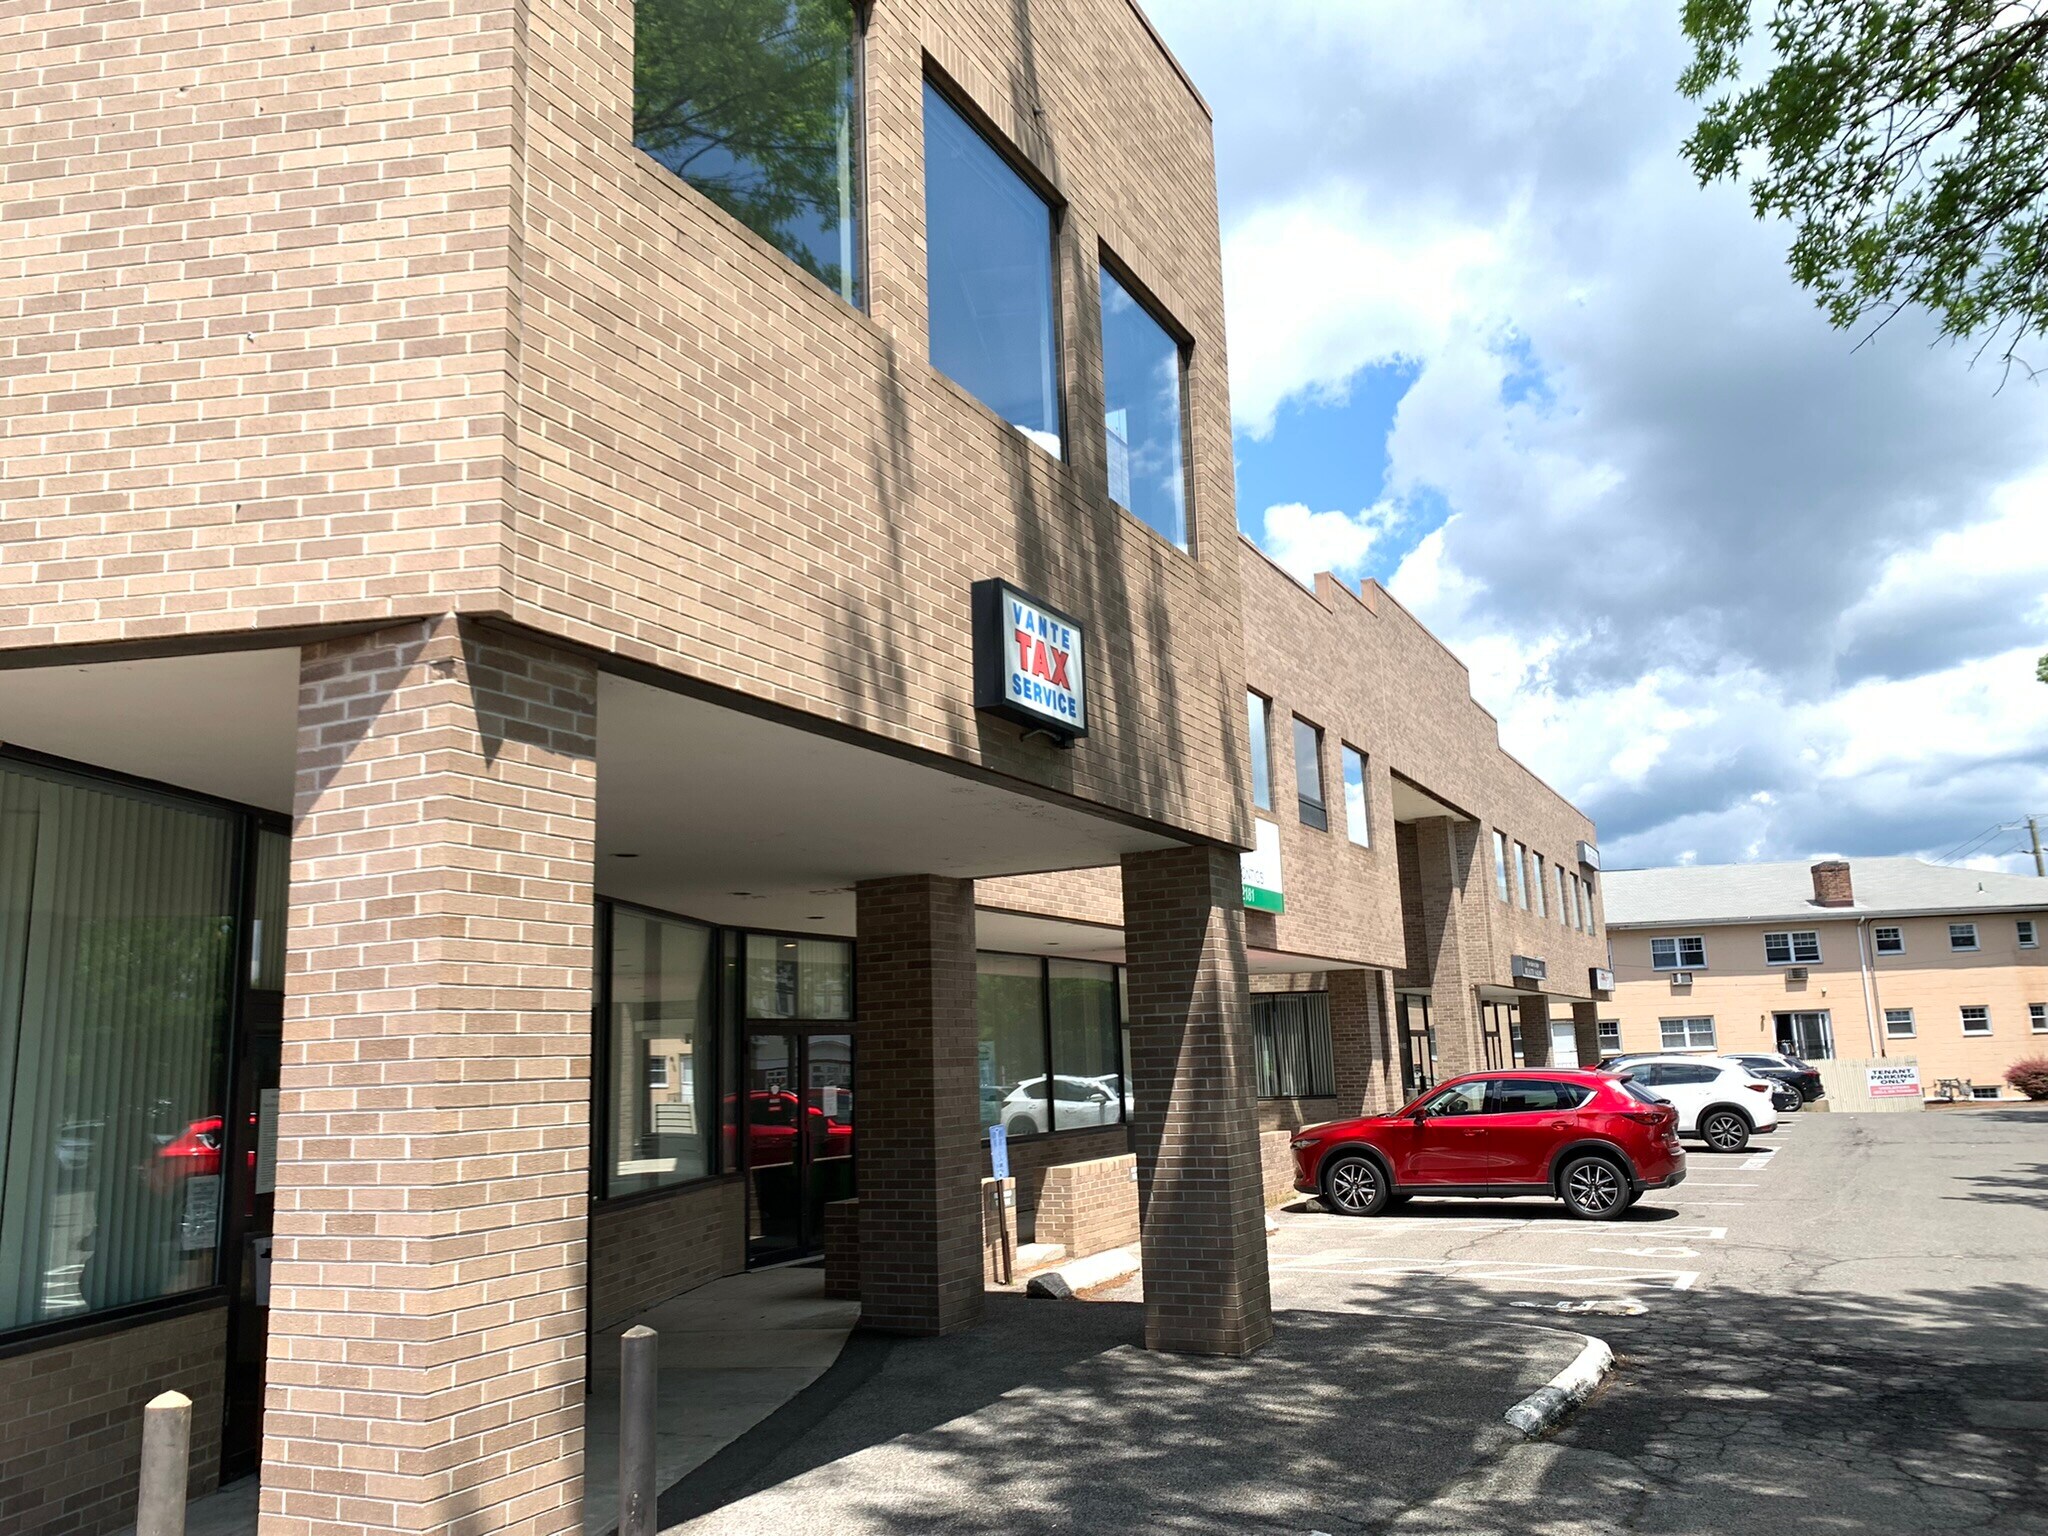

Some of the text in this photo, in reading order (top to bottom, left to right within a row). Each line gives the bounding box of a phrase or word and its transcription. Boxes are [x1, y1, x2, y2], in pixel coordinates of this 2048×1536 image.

[1013, 603, 1070, 650] VANTE
[1015, 629, 1071, 691] TAX
[1013, 673, 1076, 718] SERVICE
